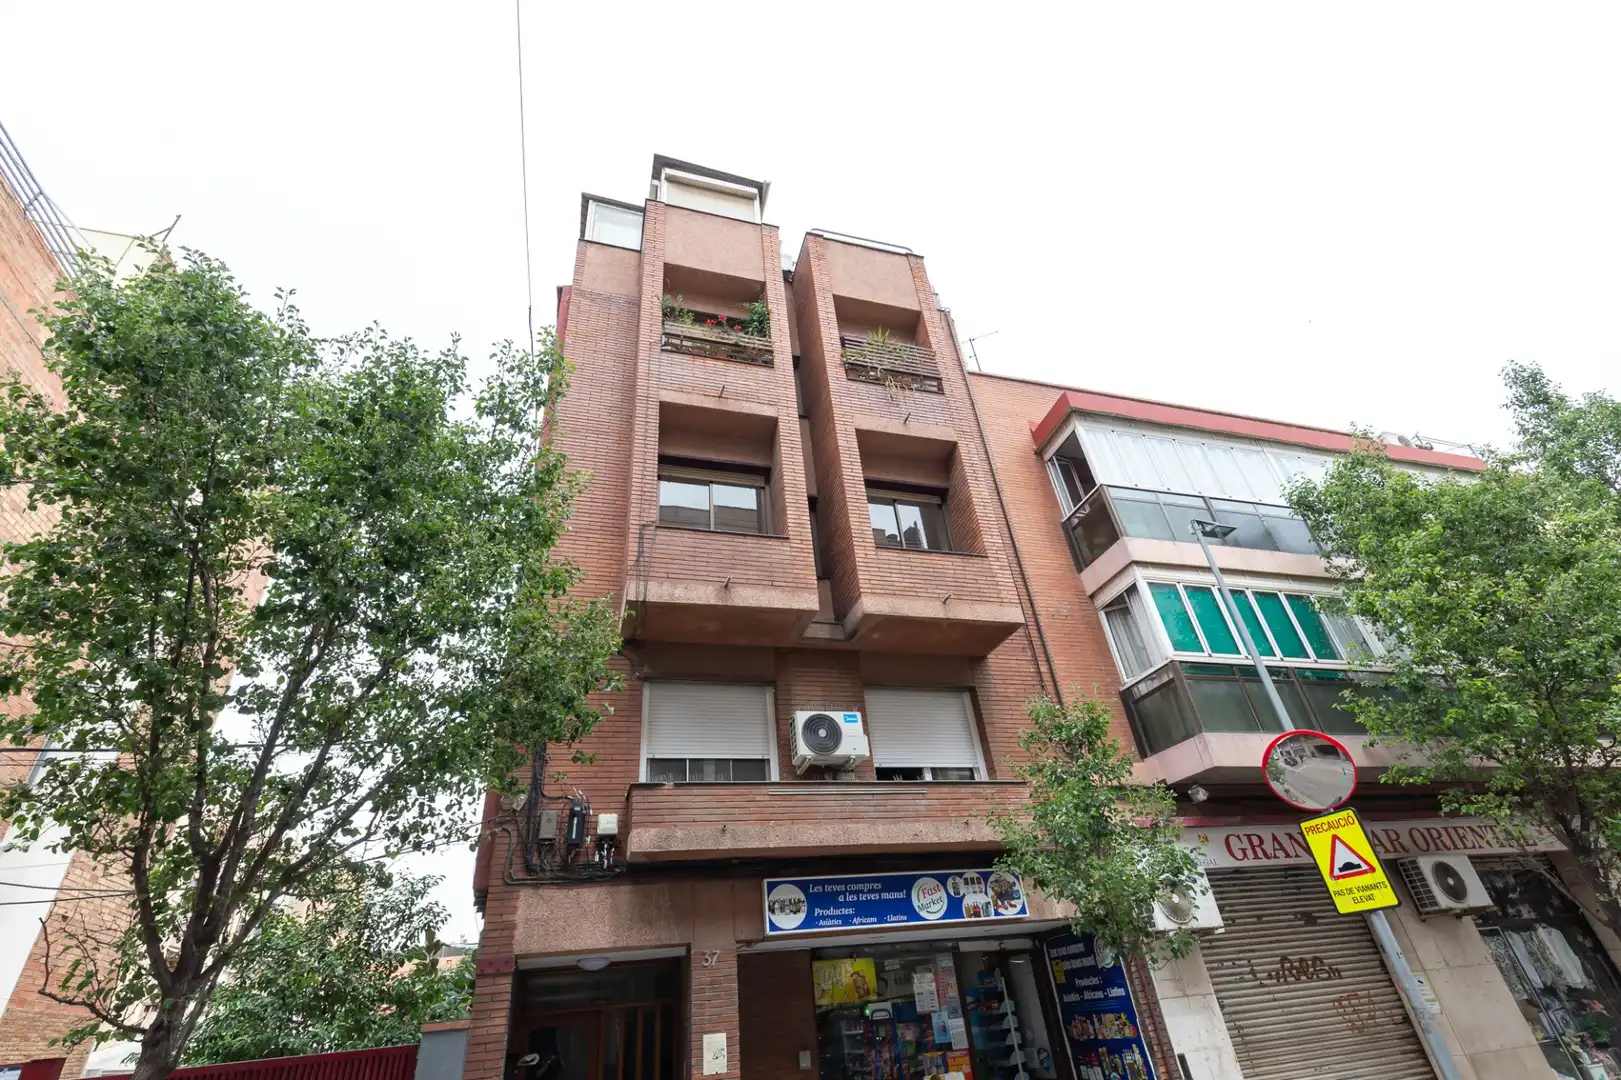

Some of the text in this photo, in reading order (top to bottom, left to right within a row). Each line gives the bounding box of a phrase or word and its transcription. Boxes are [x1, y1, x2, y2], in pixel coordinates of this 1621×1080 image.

[1304, 812, 1355, 836] PRECAUCIÓ
[1224, 825, 1538, 862] GRAN AR ORIENTL
[809, 881, 882, 893] Les teves compres
[921, 883, 943, 899] Fast
[1332, 881, 1388, 898] PAS DE VIANANTS
[838, 889, 907, 902] a les teves mans!
[917, 895, 944, 911] Market
[1352, 893, 1376, 905] ELEVAT
[814, 906, 856, 916] Productes:
[852, 916, 878, 925] Africans
[887, 914, 908, 922] Llatins
[702, 950, 720, 967] 37
